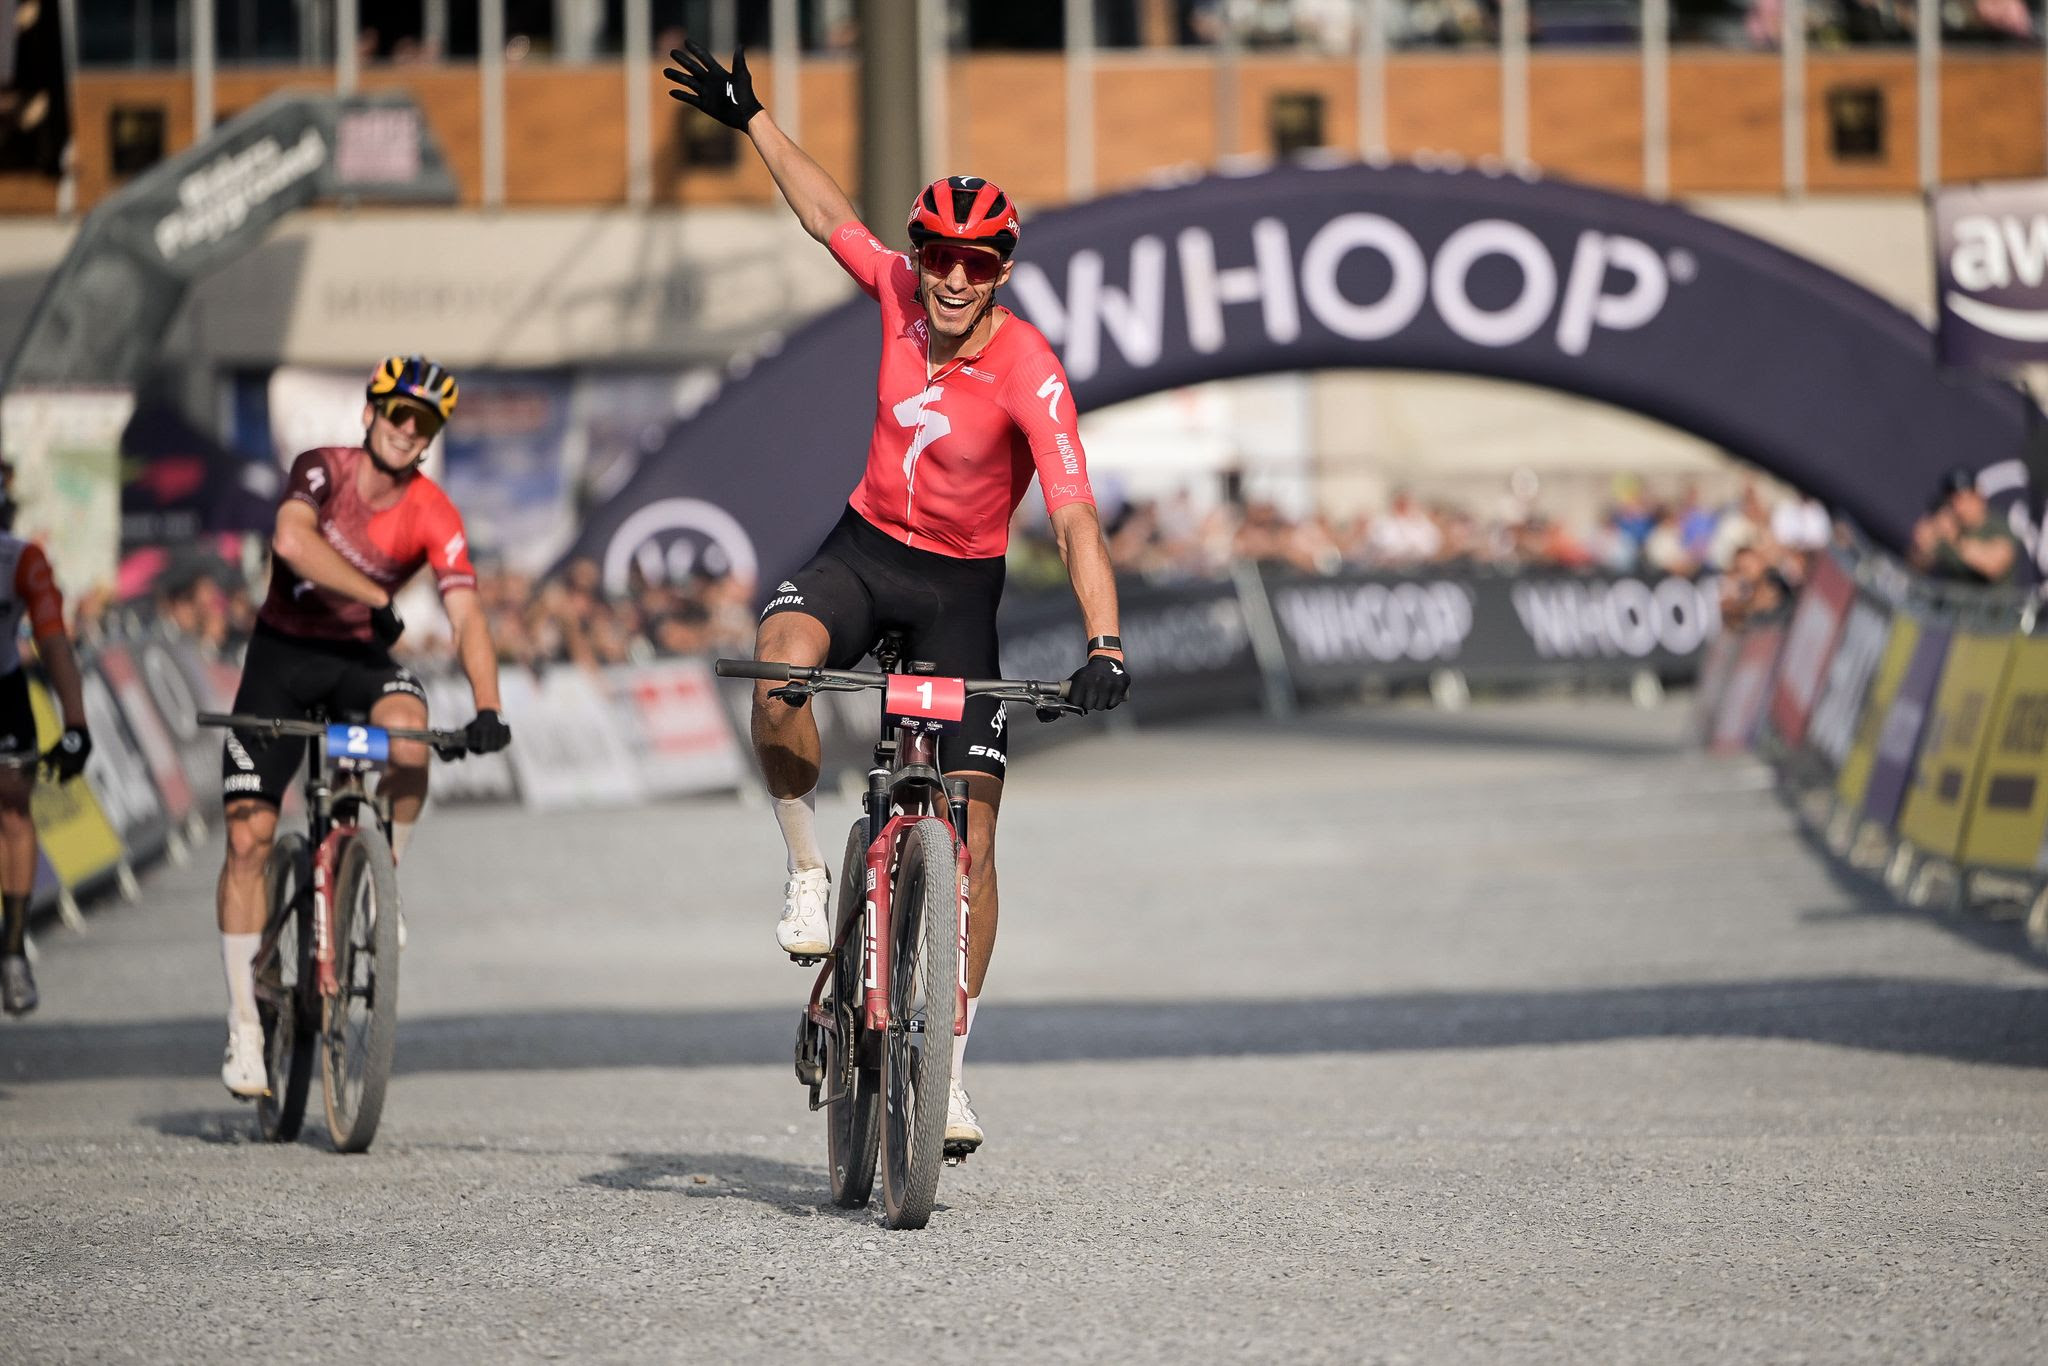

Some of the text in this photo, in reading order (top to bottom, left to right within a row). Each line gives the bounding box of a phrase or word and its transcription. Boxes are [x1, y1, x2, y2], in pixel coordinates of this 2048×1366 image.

[1011, 211, 1670, 381] WHOOP
[1055, 432, 1079, 475] ROCKSHOX
[1275, 580, 1474, 662] WHOOP
[917, 681, 932, 710] 1
[347, 725, 369, 754] 2
